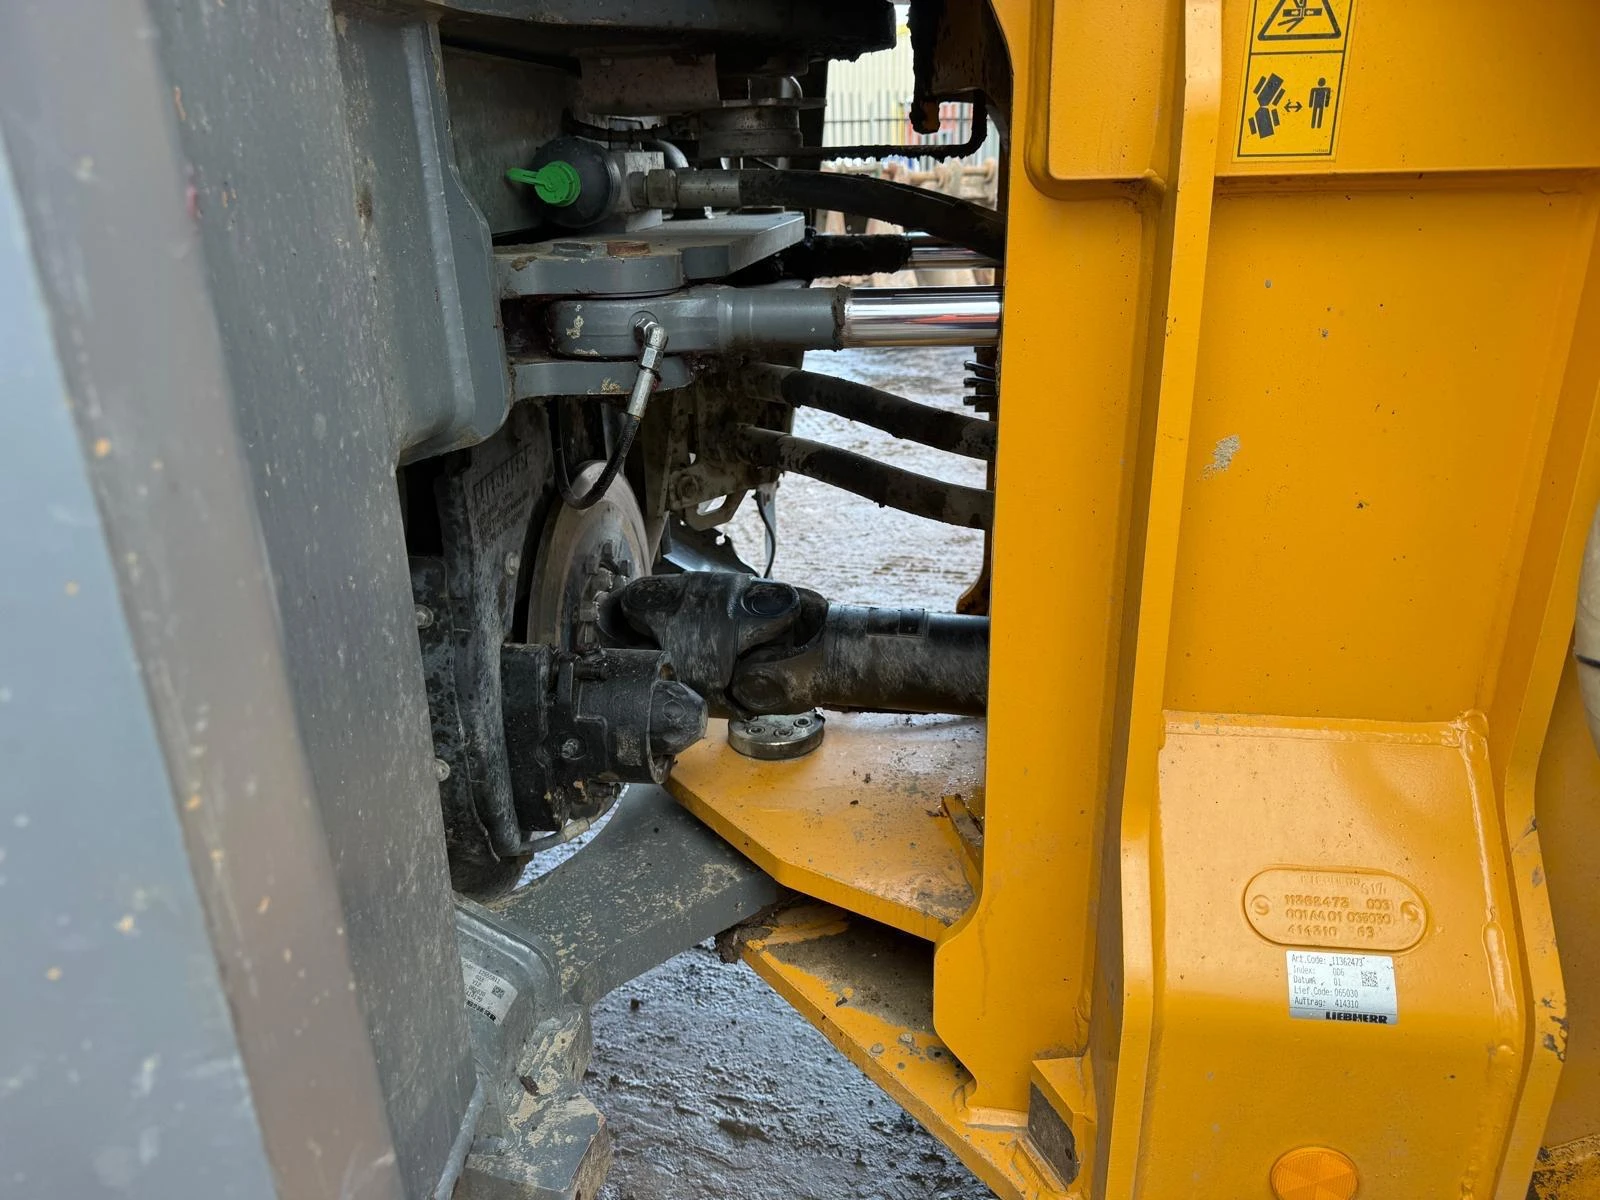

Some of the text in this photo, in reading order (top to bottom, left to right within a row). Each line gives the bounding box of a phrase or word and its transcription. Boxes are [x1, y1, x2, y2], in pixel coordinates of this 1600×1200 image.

[1332, 956, 1363, 967] 11362473
[1293, 965, 1315, 975] Index:
[1334, 988, 1359, 998] 065030
[1294, 997, 1359, 1009] Auftrag: 414310
[1325, 1011, 1388, 1025] LIEBHERR
